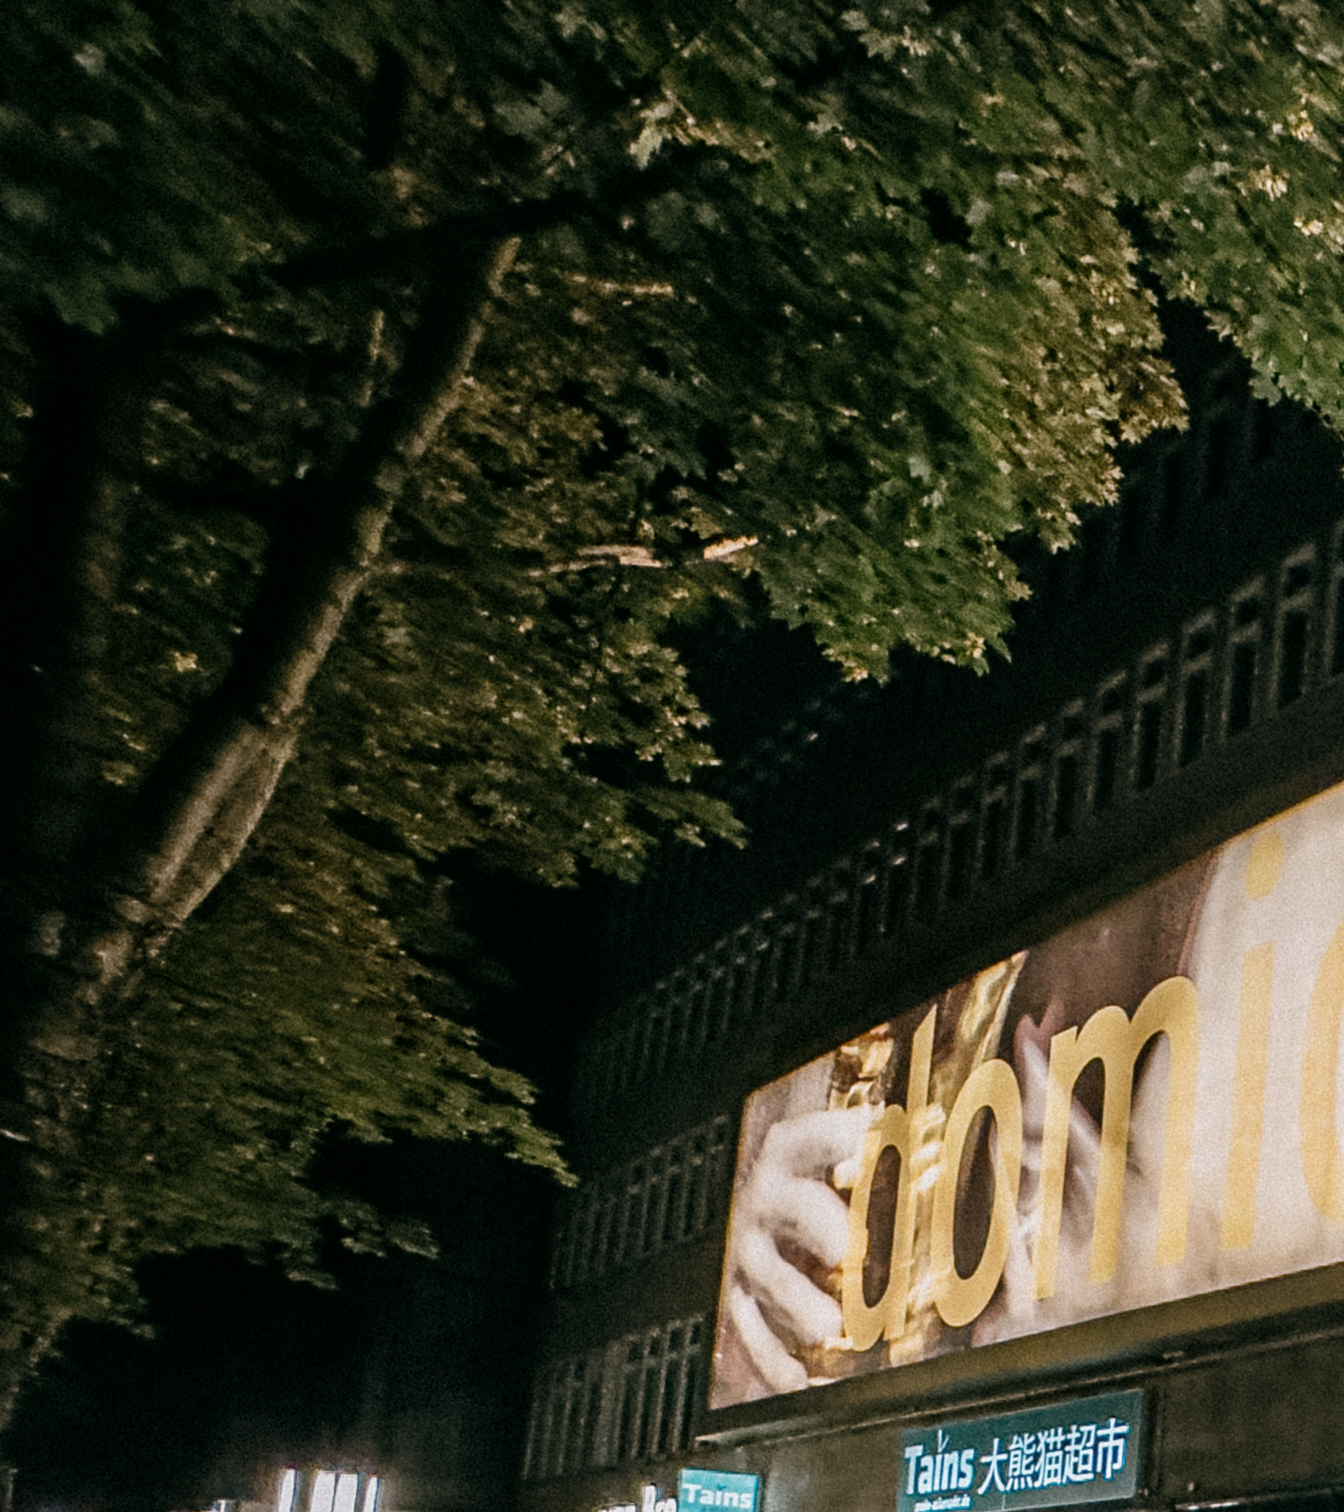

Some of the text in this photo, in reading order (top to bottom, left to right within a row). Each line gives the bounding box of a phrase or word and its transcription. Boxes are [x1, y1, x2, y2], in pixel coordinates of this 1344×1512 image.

[904, 1444, 976, 1495] Tains
[977, 1417, 1131, 1495] 大熊猫超市
[681, 1482, 753, 1509] Tains
